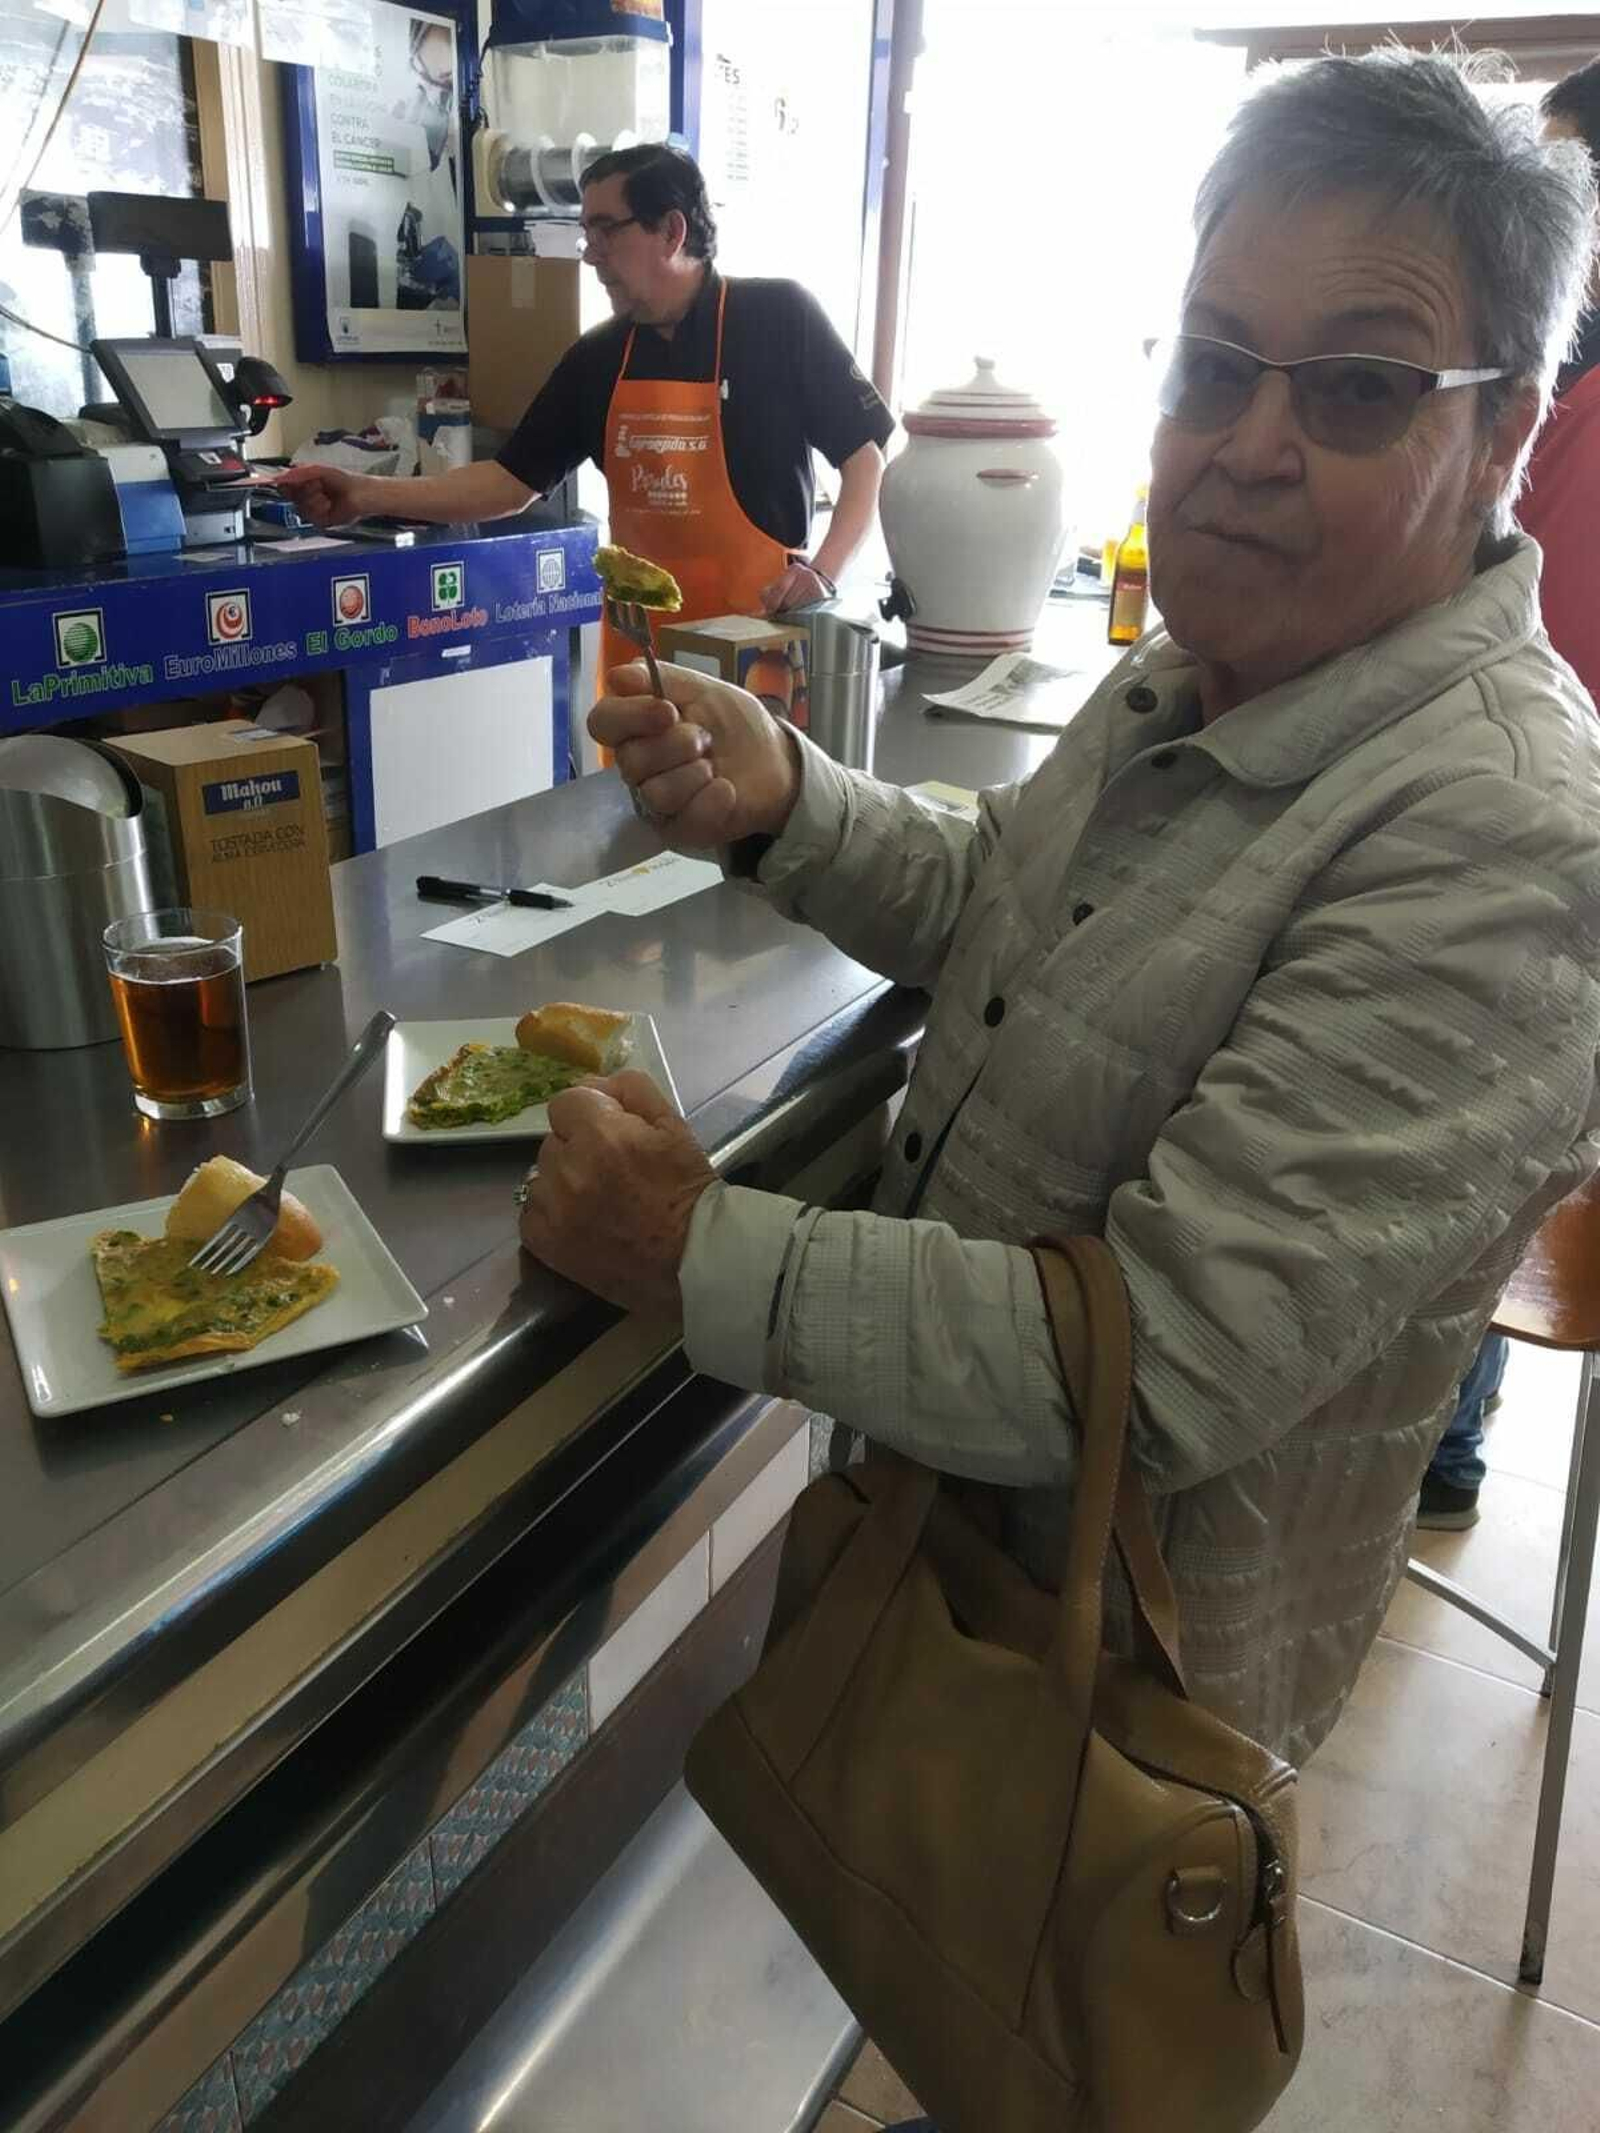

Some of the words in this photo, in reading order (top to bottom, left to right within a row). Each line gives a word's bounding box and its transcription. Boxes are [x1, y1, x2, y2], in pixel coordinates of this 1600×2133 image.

[306, 631, 328, 656] El
[334, 622, 398, 651] Gordo
[407, 607, 489, 639] BonoLoto
[164, 641, 298, 681] EuroMillones
[12, 663, 154, 706] LaPrimitiva
[221, 779, 282, 801] Mahou
